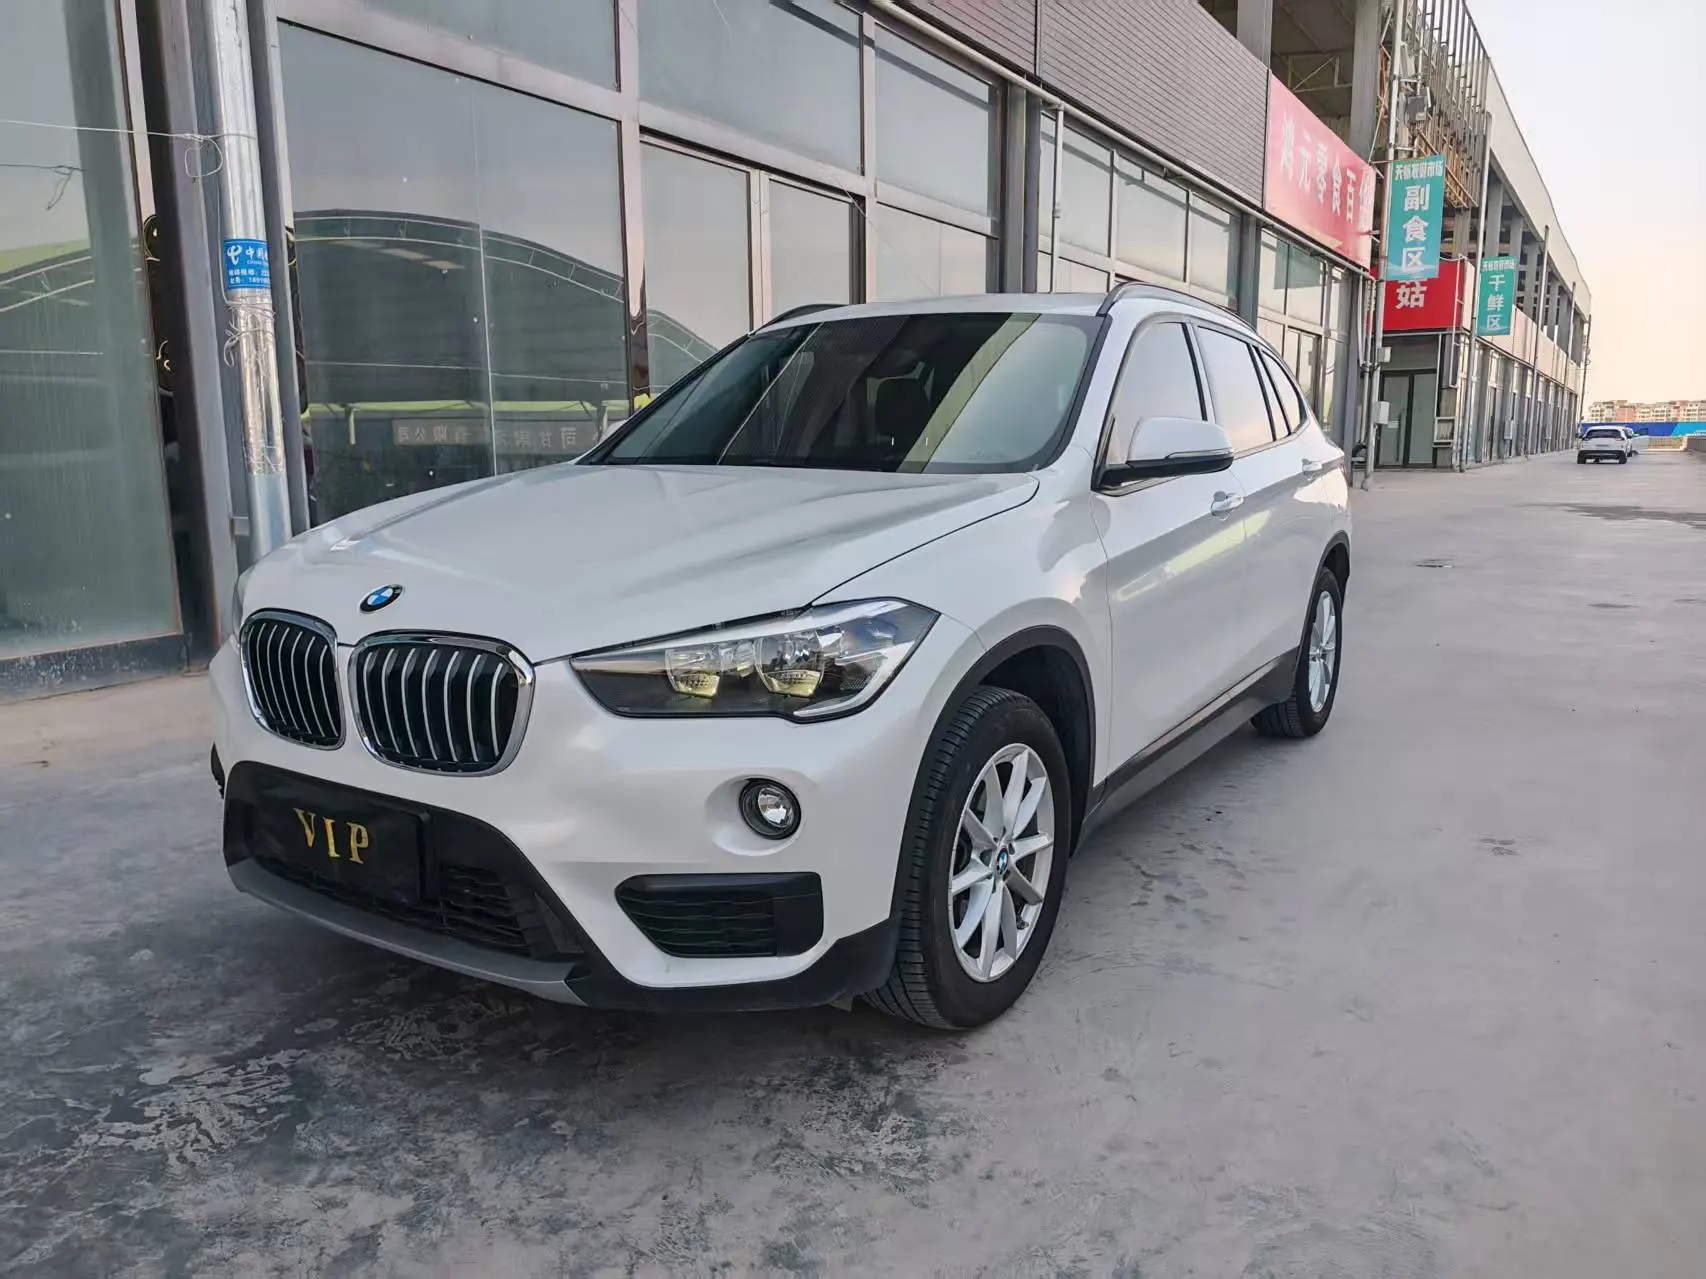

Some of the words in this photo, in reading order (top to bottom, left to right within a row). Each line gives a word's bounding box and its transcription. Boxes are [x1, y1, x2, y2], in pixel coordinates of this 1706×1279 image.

[1402, 184, 1431, 273] 副食区
[1486, 274, 1506, 331] 干鲜区
[293, 807, 369, 864] VIP
